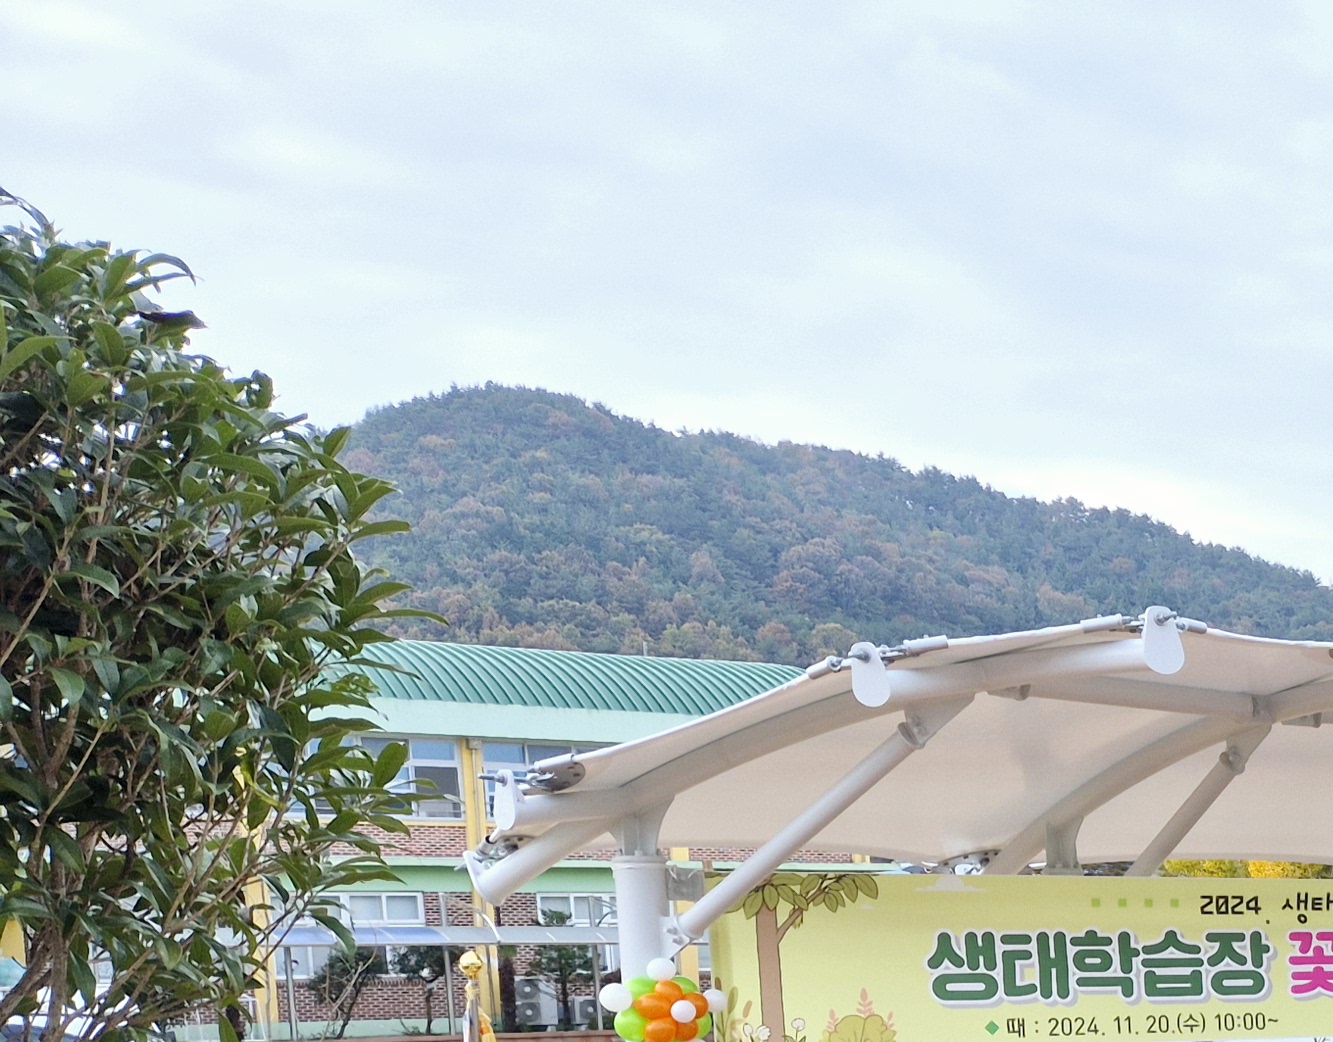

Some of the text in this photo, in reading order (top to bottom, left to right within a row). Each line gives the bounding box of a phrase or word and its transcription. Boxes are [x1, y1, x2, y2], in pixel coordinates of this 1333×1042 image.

[924, 927, 1271, 1001] 생태학습장
[1006, 1017, 1026, 1038] 때
[1048, 1016, 1106, 1037] 2024.
